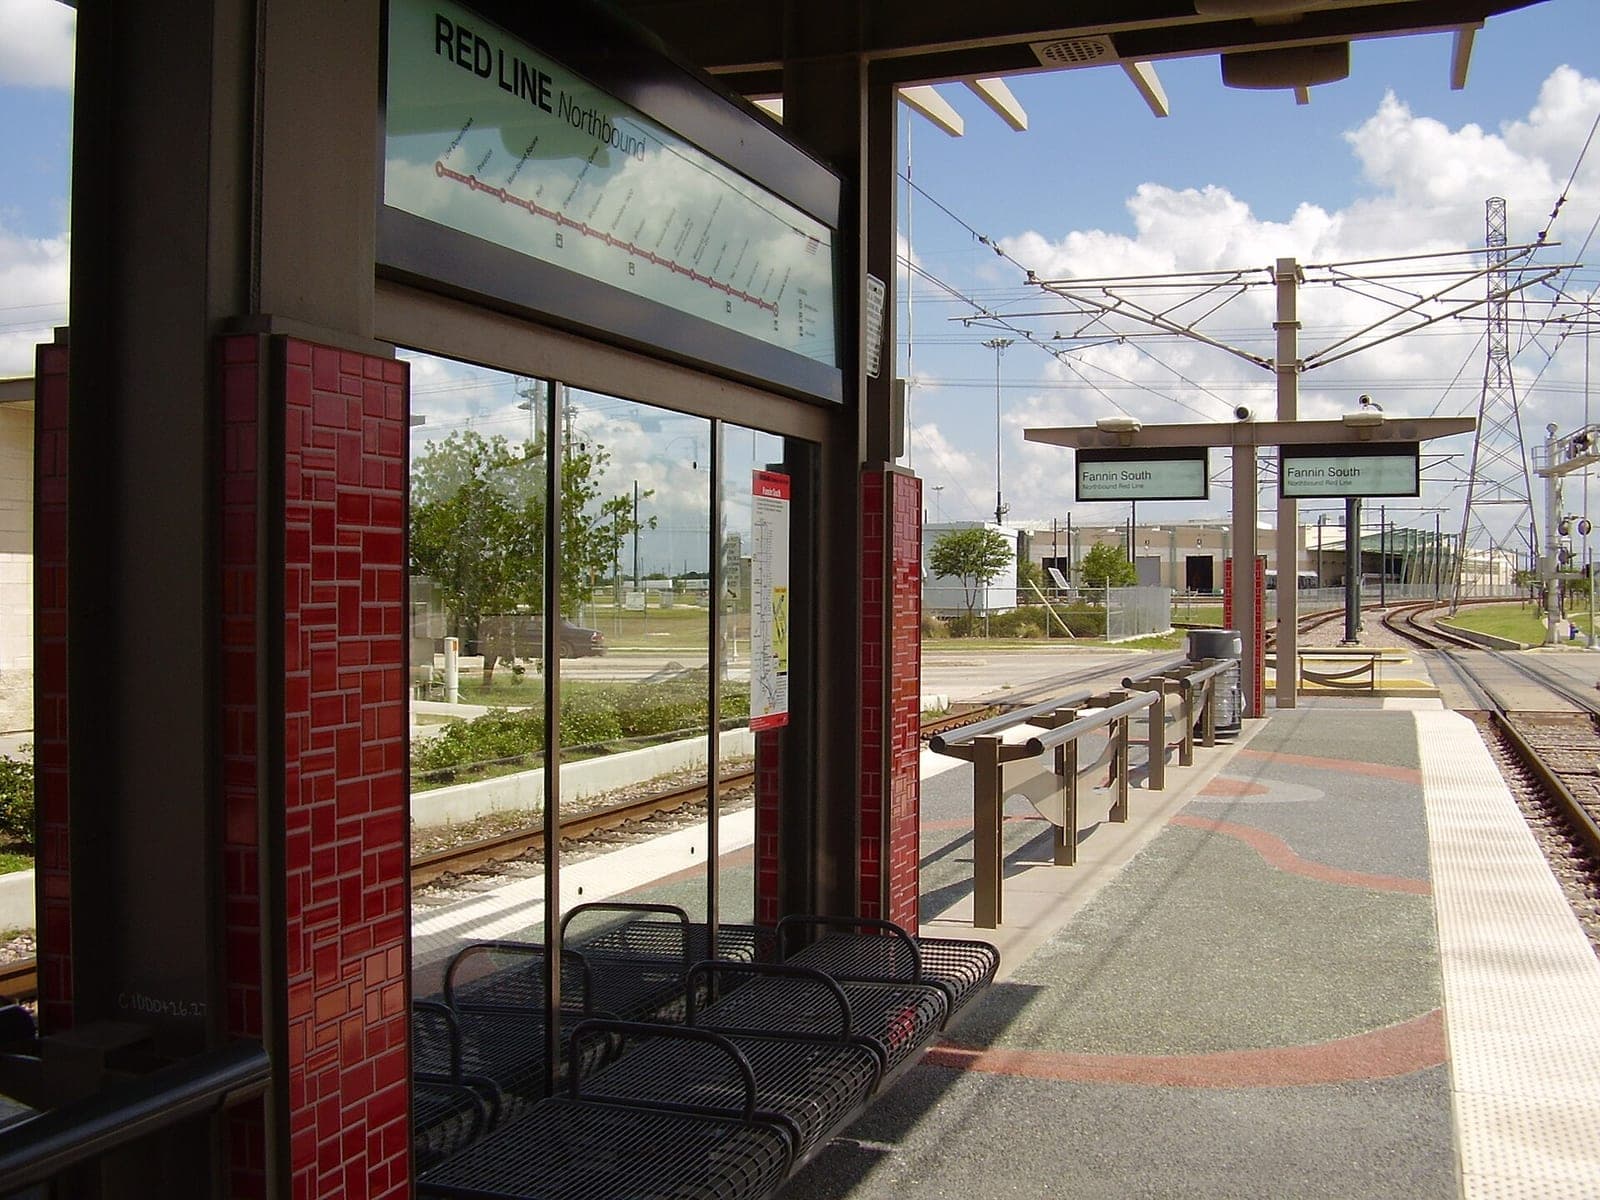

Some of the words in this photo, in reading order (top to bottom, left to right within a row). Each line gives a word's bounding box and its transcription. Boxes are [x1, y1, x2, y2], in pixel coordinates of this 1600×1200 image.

[435, 13, 492, 79] RED
[498, 48, 552, 114] LINE
[558, 90, 646, 162] Northbound
[1082, 471, 1118, 482] Fannin
[1120, 470, 1152, 481] South
[1287, 467, 1325, 478] Fannin
[1327, 466, 1360, 477] South
